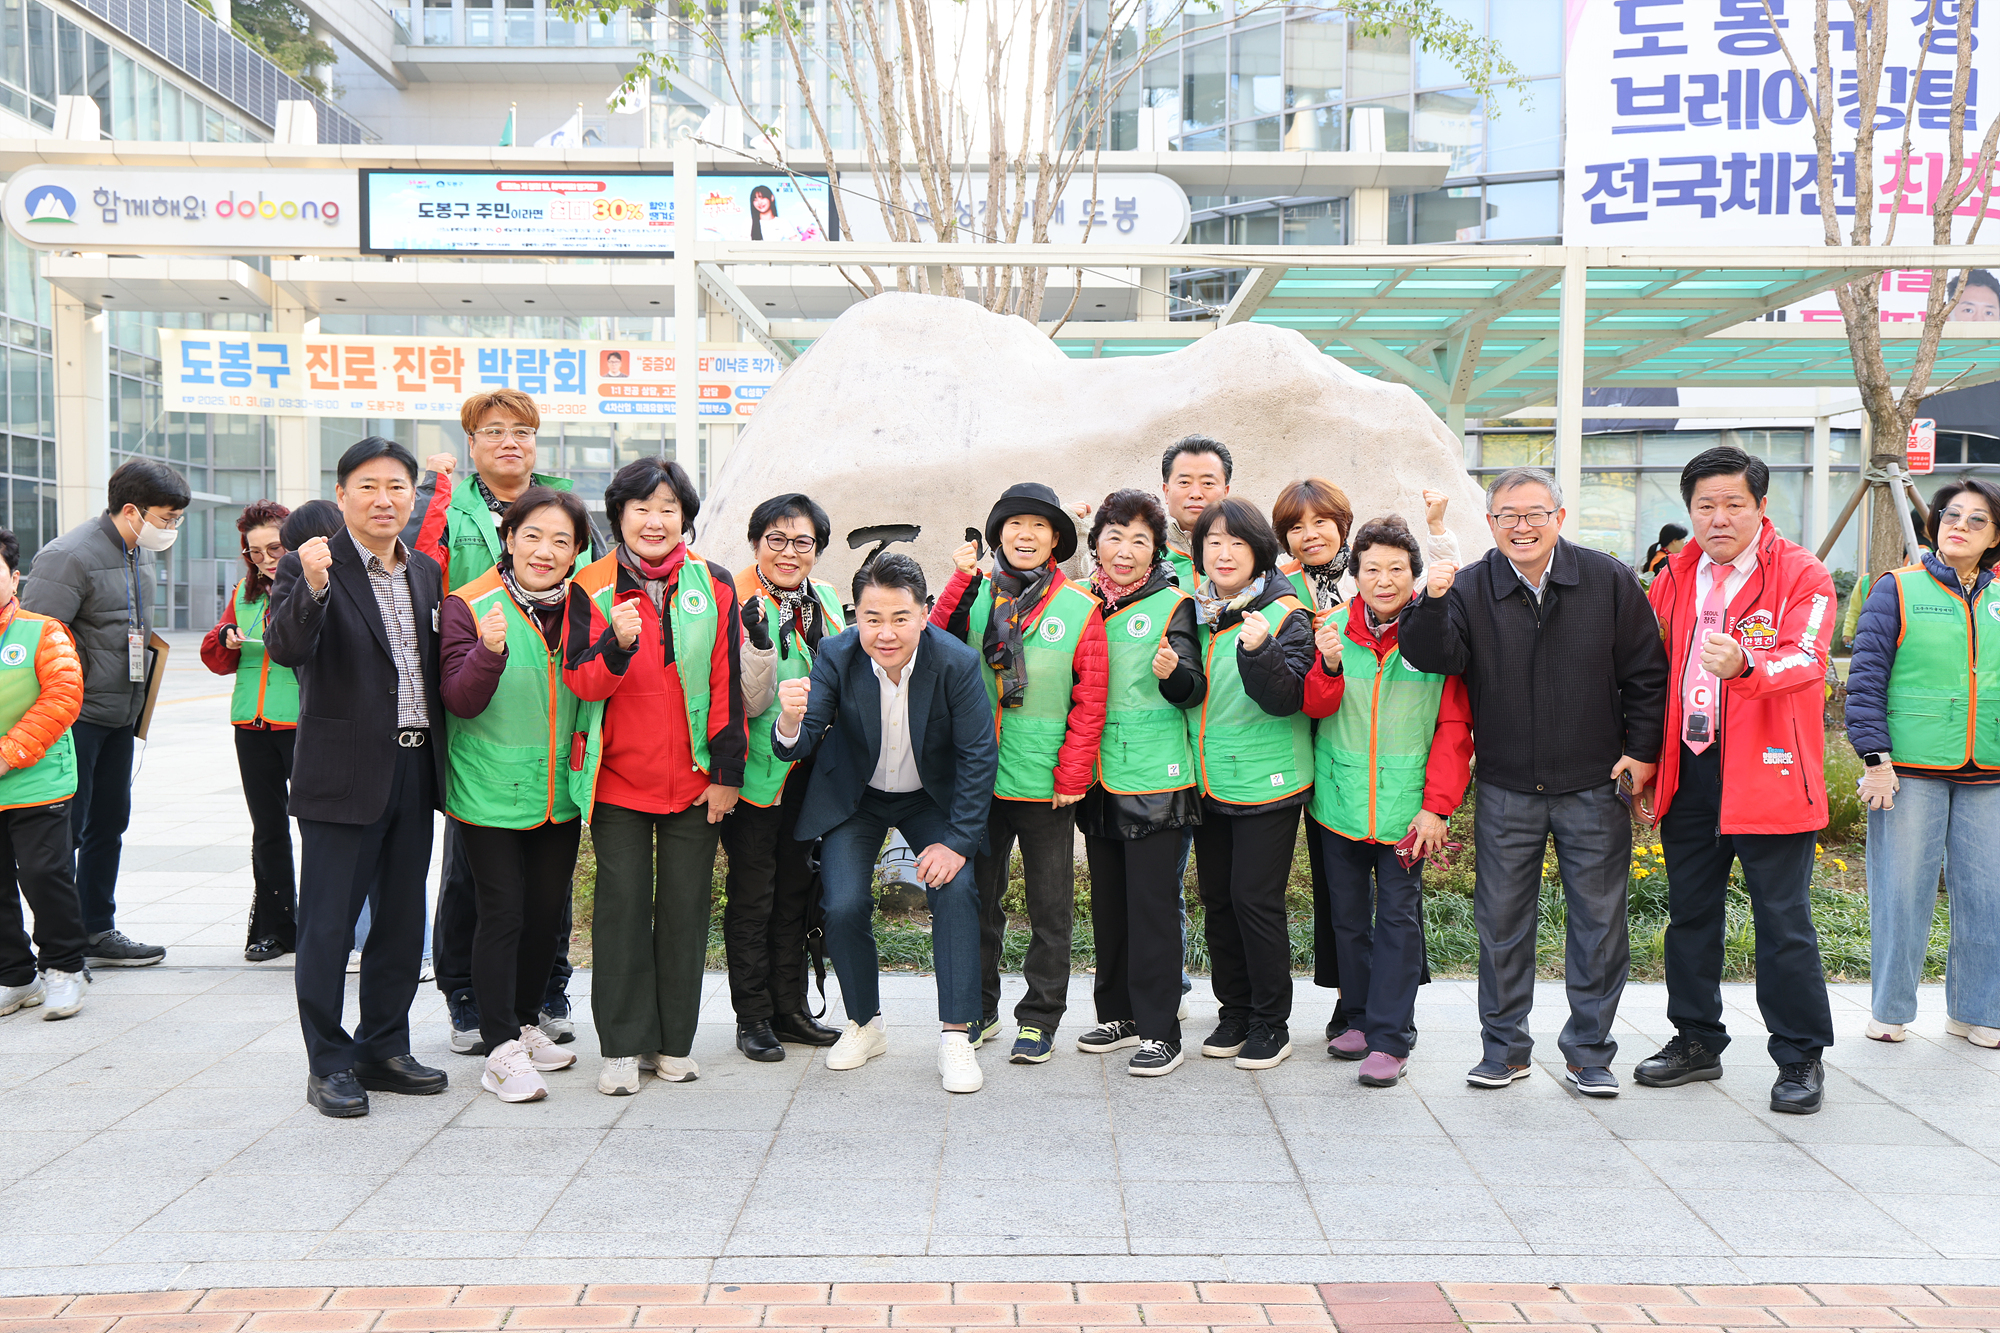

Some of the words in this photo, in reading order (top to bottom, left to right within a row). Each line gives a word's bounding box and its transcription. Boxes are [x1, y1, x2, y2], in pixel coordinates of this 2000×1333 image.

[1610, 66, 1979, 135] 브레이킹팀
[93, 186, 207, 224] 함께해요!
[215, 190, 340, 226] dobong
[1581, 151, 1857, 225] 전국체전
[418, 202, 470, 219] 도봉구
[592, 198, 645, 222] 30%
[1078, 196, 1139, 234] 도봉
[180, 339, 291, 389] 도봉구
[477, 347, 587, 396] 박람회
[752, 358, 775, 373] 작가
[367, 400, 405, 412] 도봉구청
